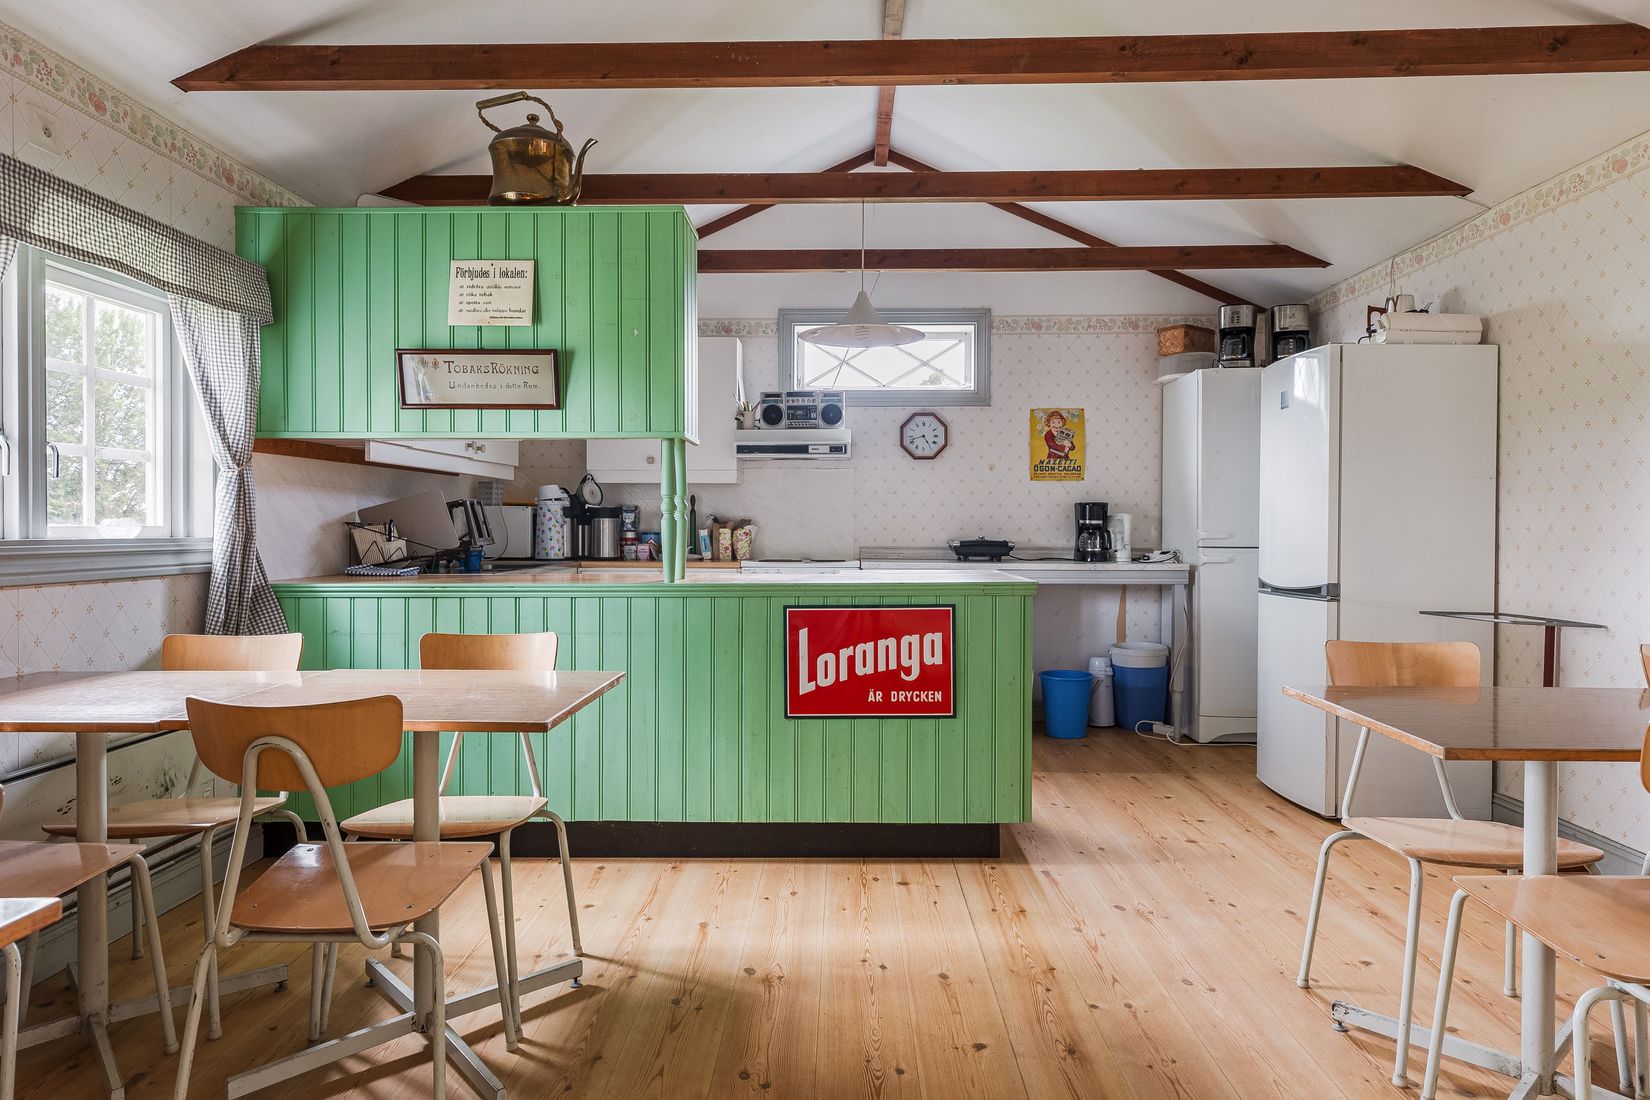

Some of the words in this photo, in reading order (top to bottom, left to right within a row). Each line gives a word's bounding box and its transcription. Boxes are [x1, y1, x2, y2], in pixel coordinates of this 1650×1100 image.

[455, 267, 490, 280] Förbjudes
[499, 267, 528, 278] lokalen:
[798, 627, 943, 696] Loranga
[867, 689, 883, 702] ÄR
[890, 690, 942, 702] DRYCKEN
